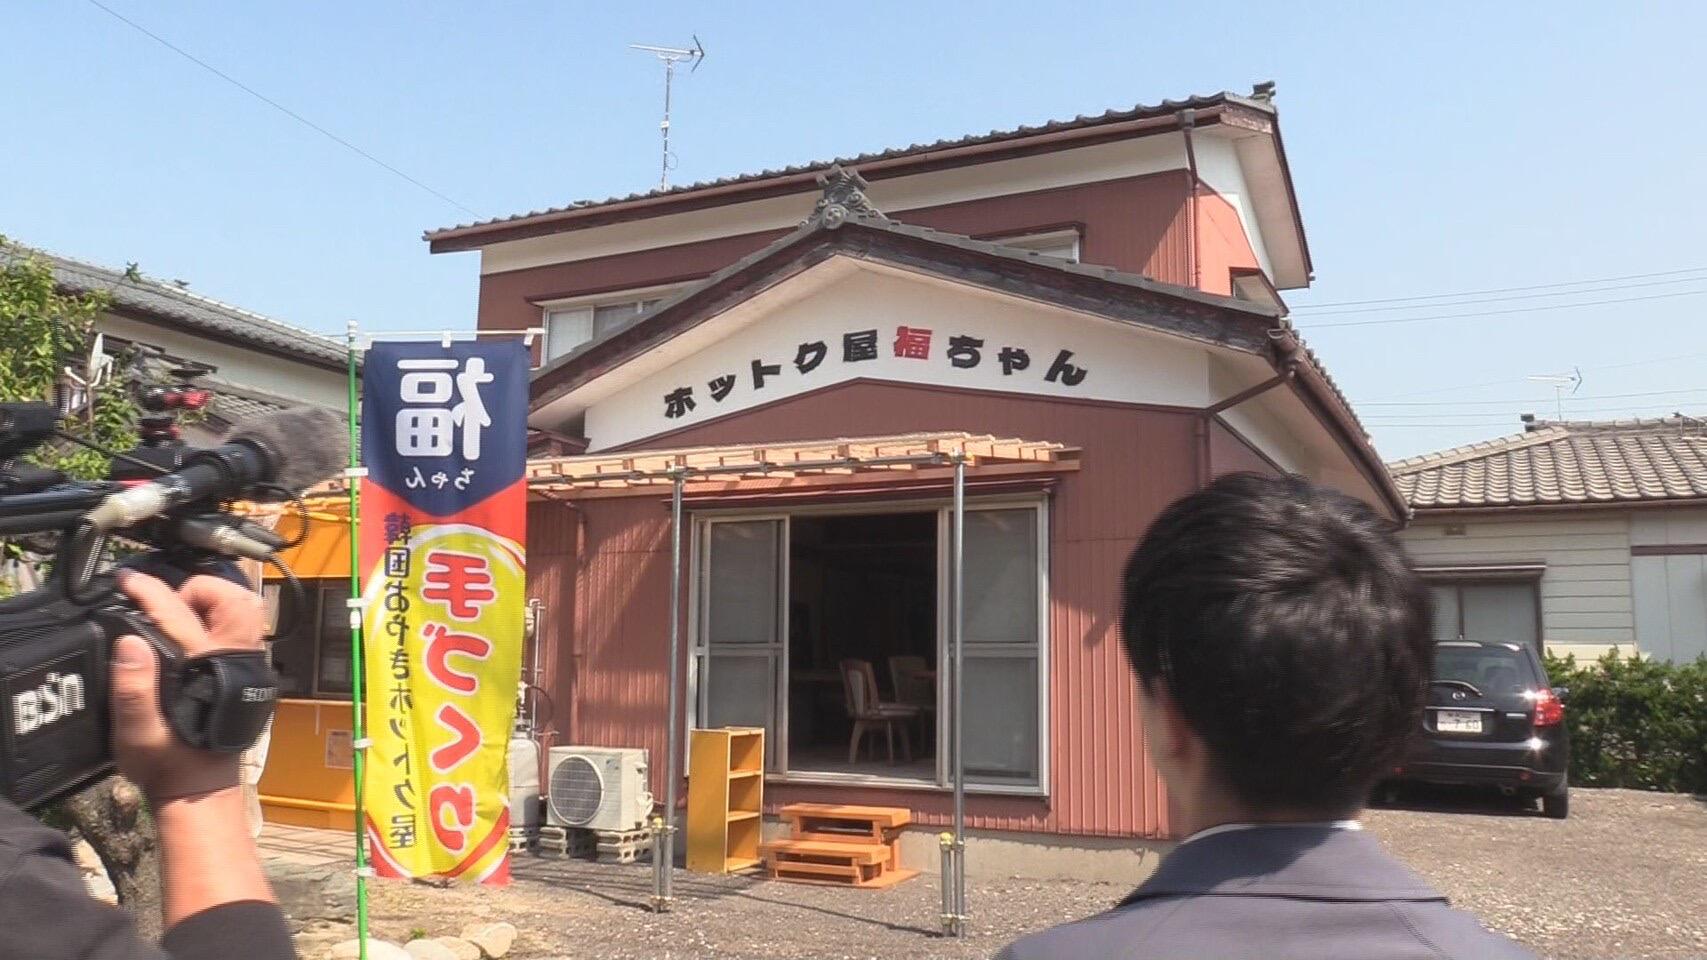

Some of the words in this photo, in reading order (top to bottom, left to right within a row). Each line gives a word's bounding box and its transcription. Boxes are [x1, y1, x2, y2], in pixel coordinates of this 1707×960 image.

[664, 326, 1088, 419] ホットク屋福ちゃん
